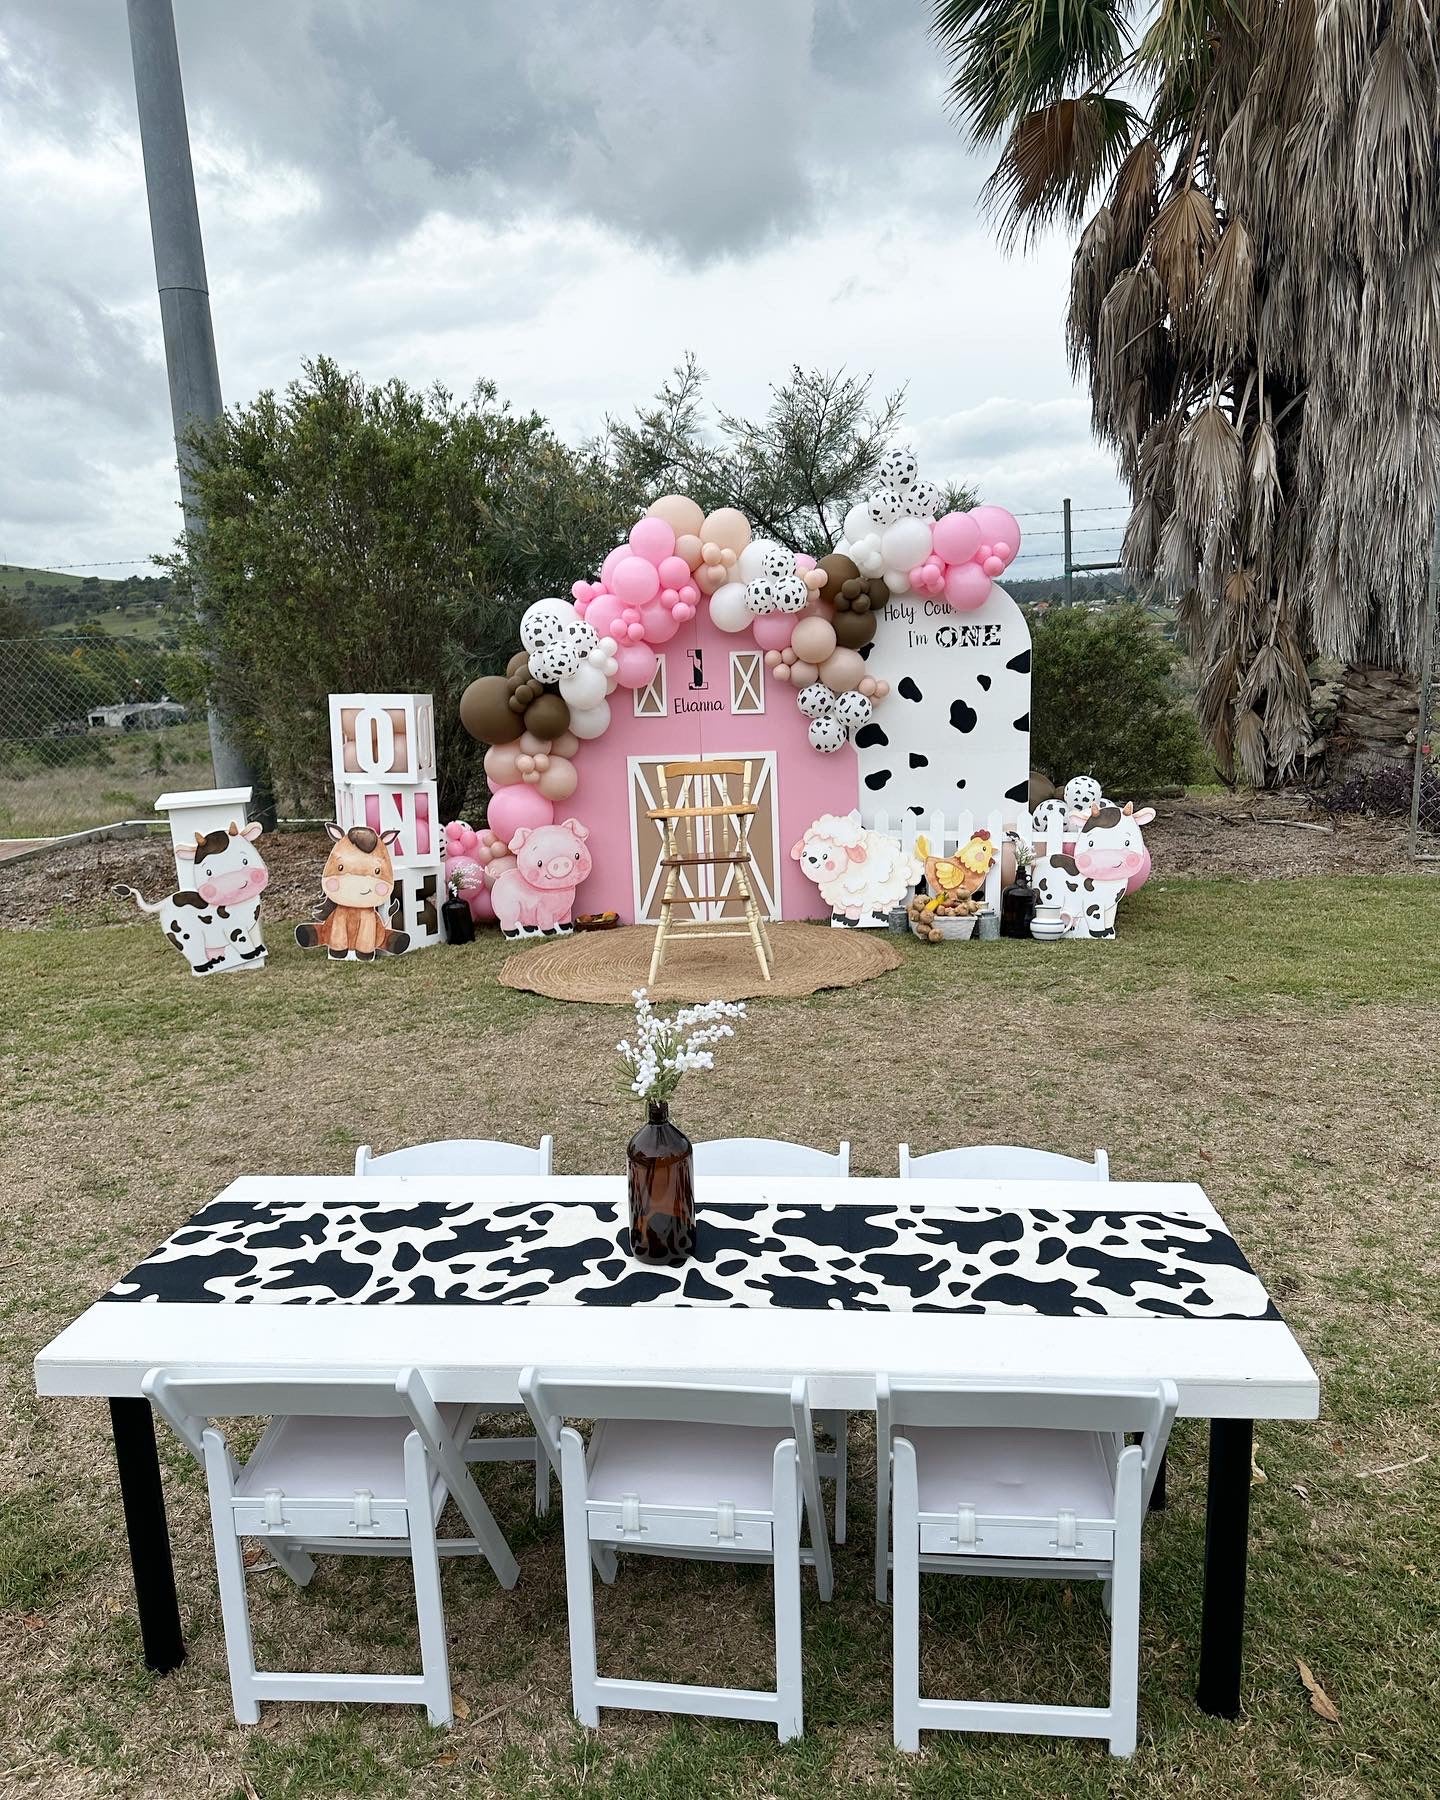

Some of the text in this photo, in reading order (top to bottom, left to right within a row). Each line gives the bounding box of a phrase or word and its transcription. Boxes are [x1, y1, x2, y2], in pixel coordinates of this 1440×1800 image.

[884, 600, 957, 624] Holy Cow
[908, 624, 1001, 648] I'm ONE
[687, 649, 708, 690] 1
[674, 698, 725, 714] Elianna
